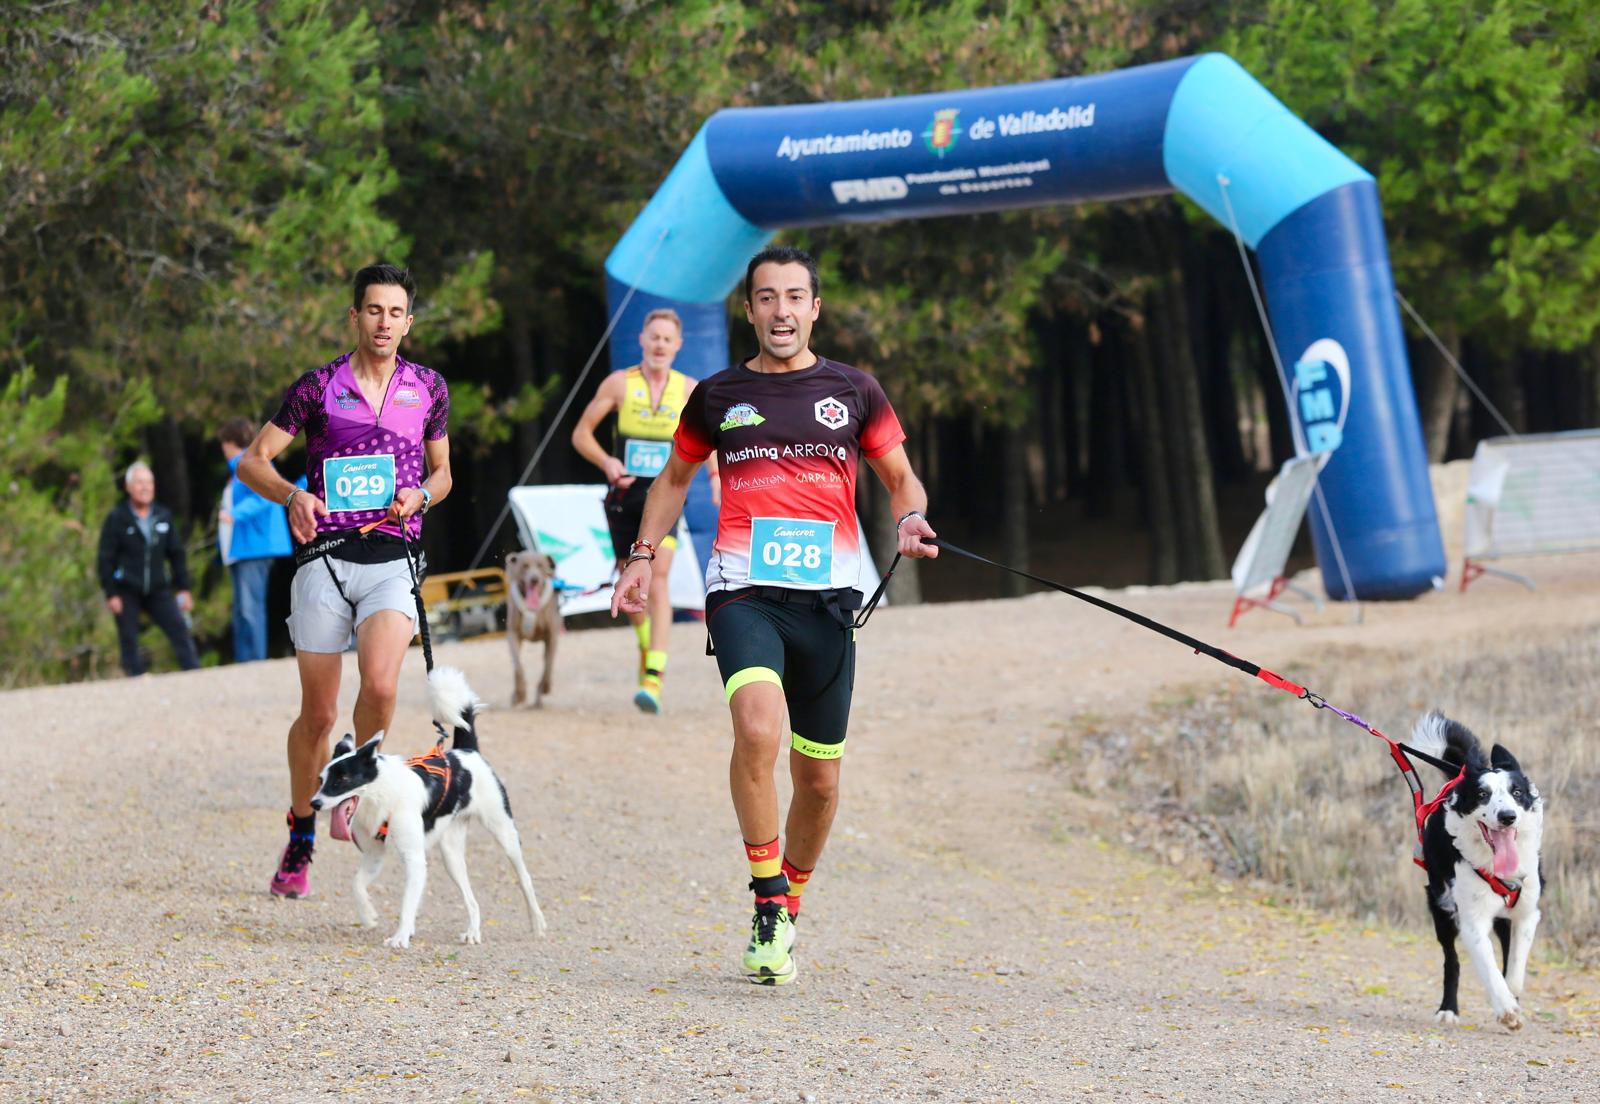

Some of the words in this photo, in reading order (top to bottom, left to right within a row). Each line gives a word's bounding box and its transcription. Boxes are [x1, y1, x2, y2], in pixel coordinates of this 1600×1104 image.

[777, 129, 912, 161] Ayuntamiento
[970, 117, 995, 139] de
[998, 103, 1095, 136] Valladolid
[726, 445, 778, 464] Mushing
[342, 463, 378, 473] Canicross
[336, 475, 385, 498] 029
[773, 526, 816, 537] Canicross
[762, 541, 821, 569] 028
[802, 745, 838, 755] land
